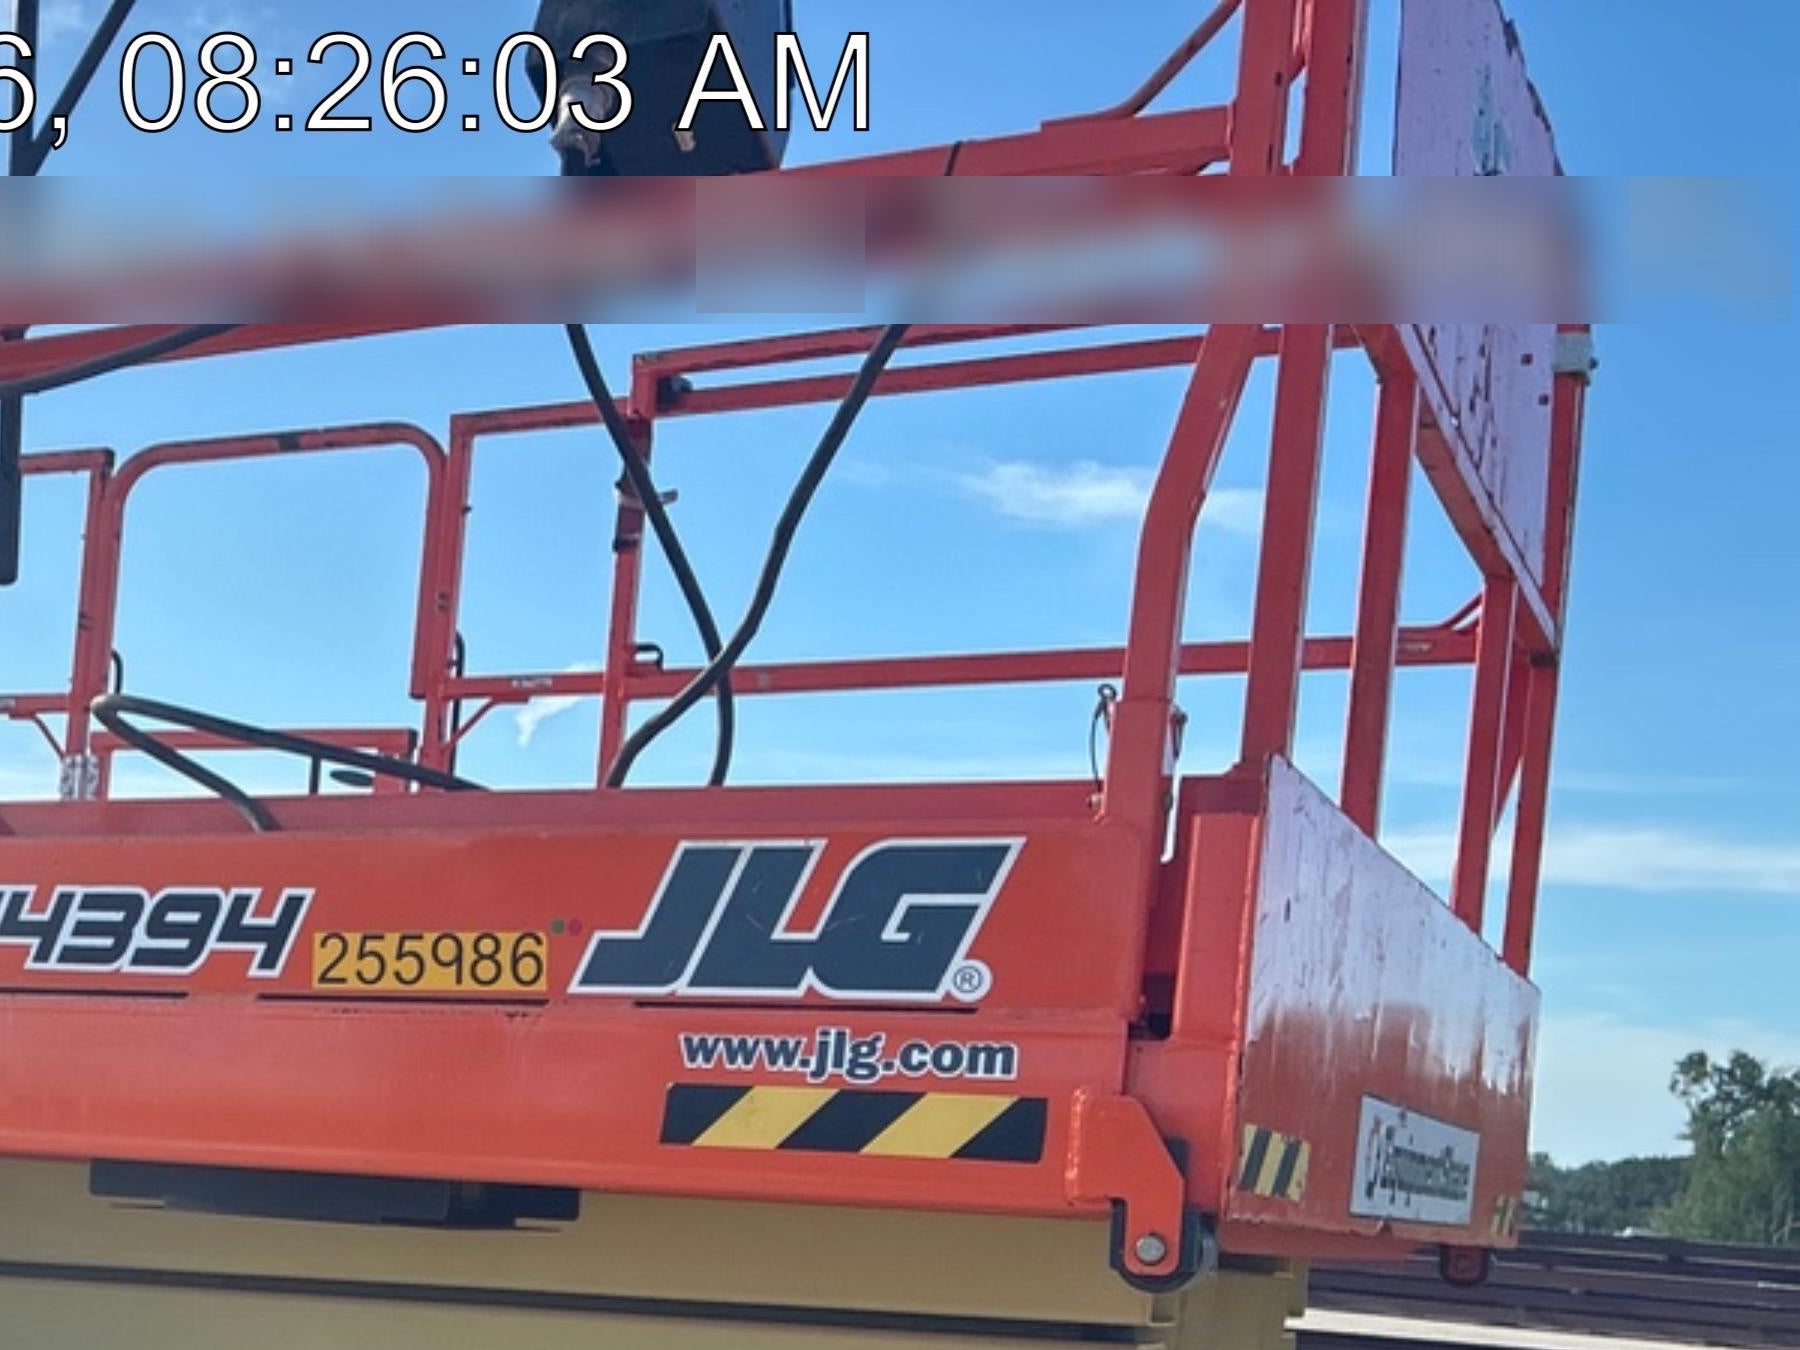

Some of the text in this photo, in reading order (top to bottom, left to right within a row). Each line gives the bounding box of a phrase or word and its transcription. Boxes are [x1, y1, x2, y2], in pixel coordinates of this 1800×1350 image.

[567, 836, 1027, 1001] JLG
[316, 931, 547, 986] 255986
[680, 1027, 1018, 1082] www.jlg.com
